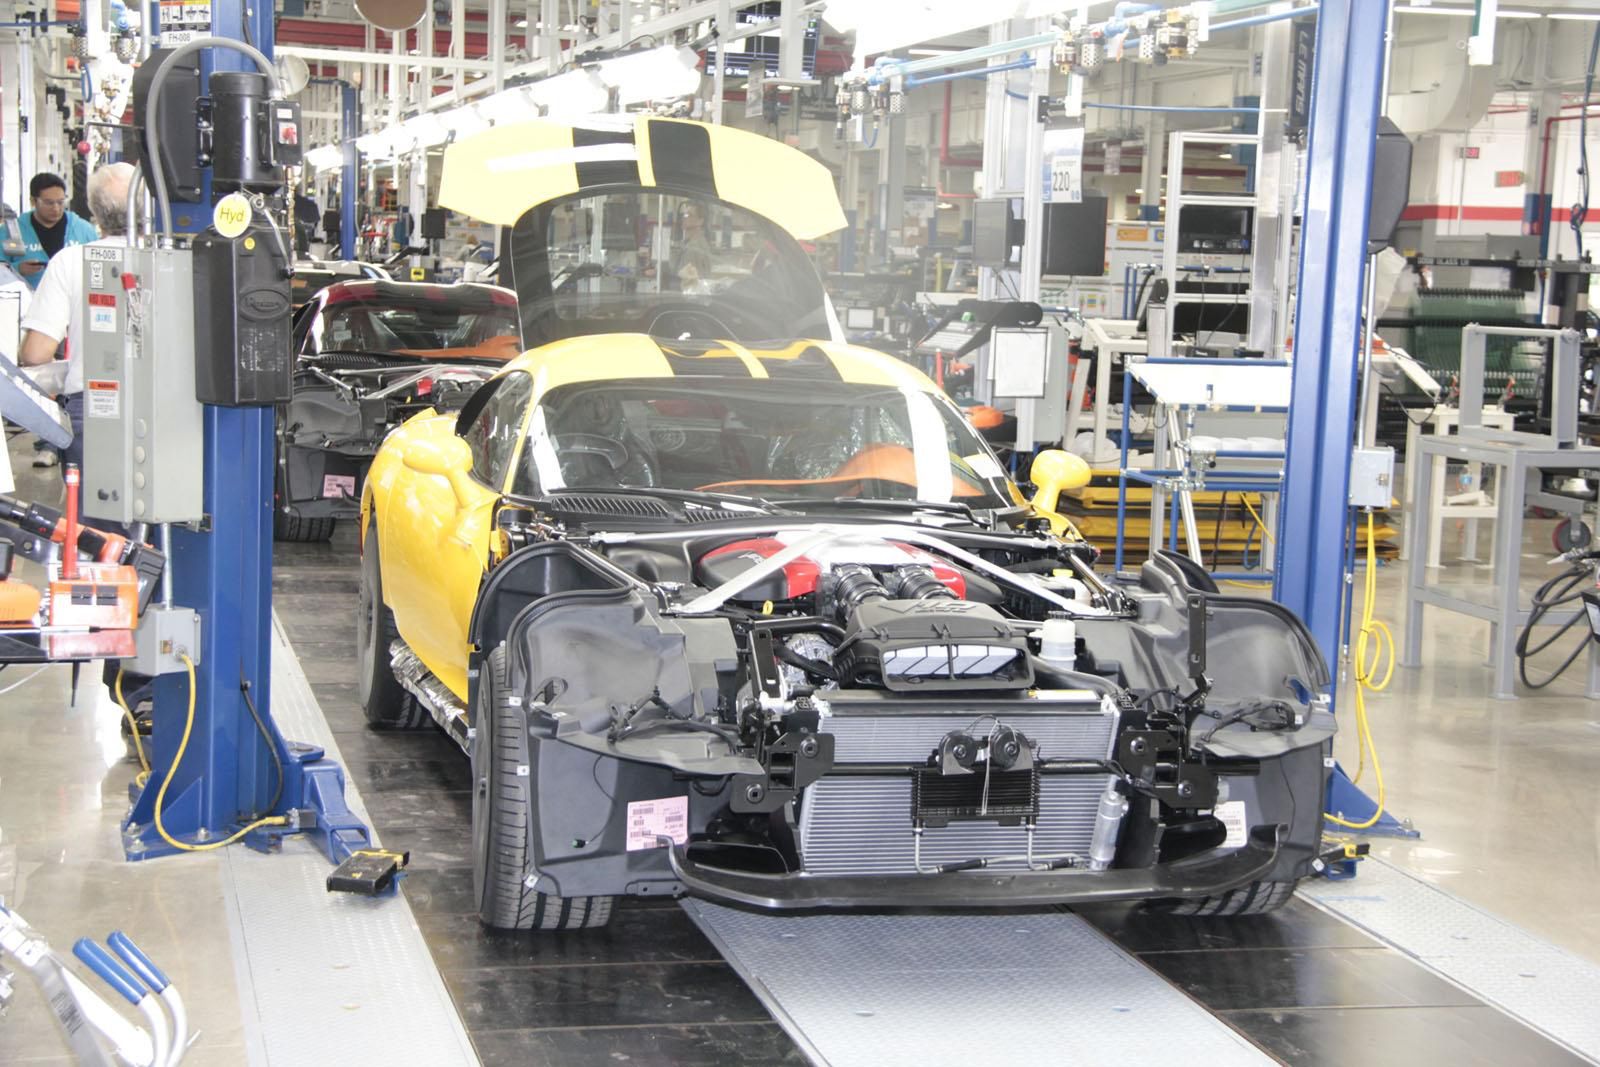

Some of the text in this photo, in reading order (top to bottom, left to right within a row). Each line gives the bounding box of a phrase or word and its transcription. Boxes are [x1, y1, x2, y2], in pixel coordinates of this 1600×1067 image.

[1053, 171, 1070, 191] 220
[219, 207, 244, 224] Hyd
[91, 248, 116, 259] FH-008
